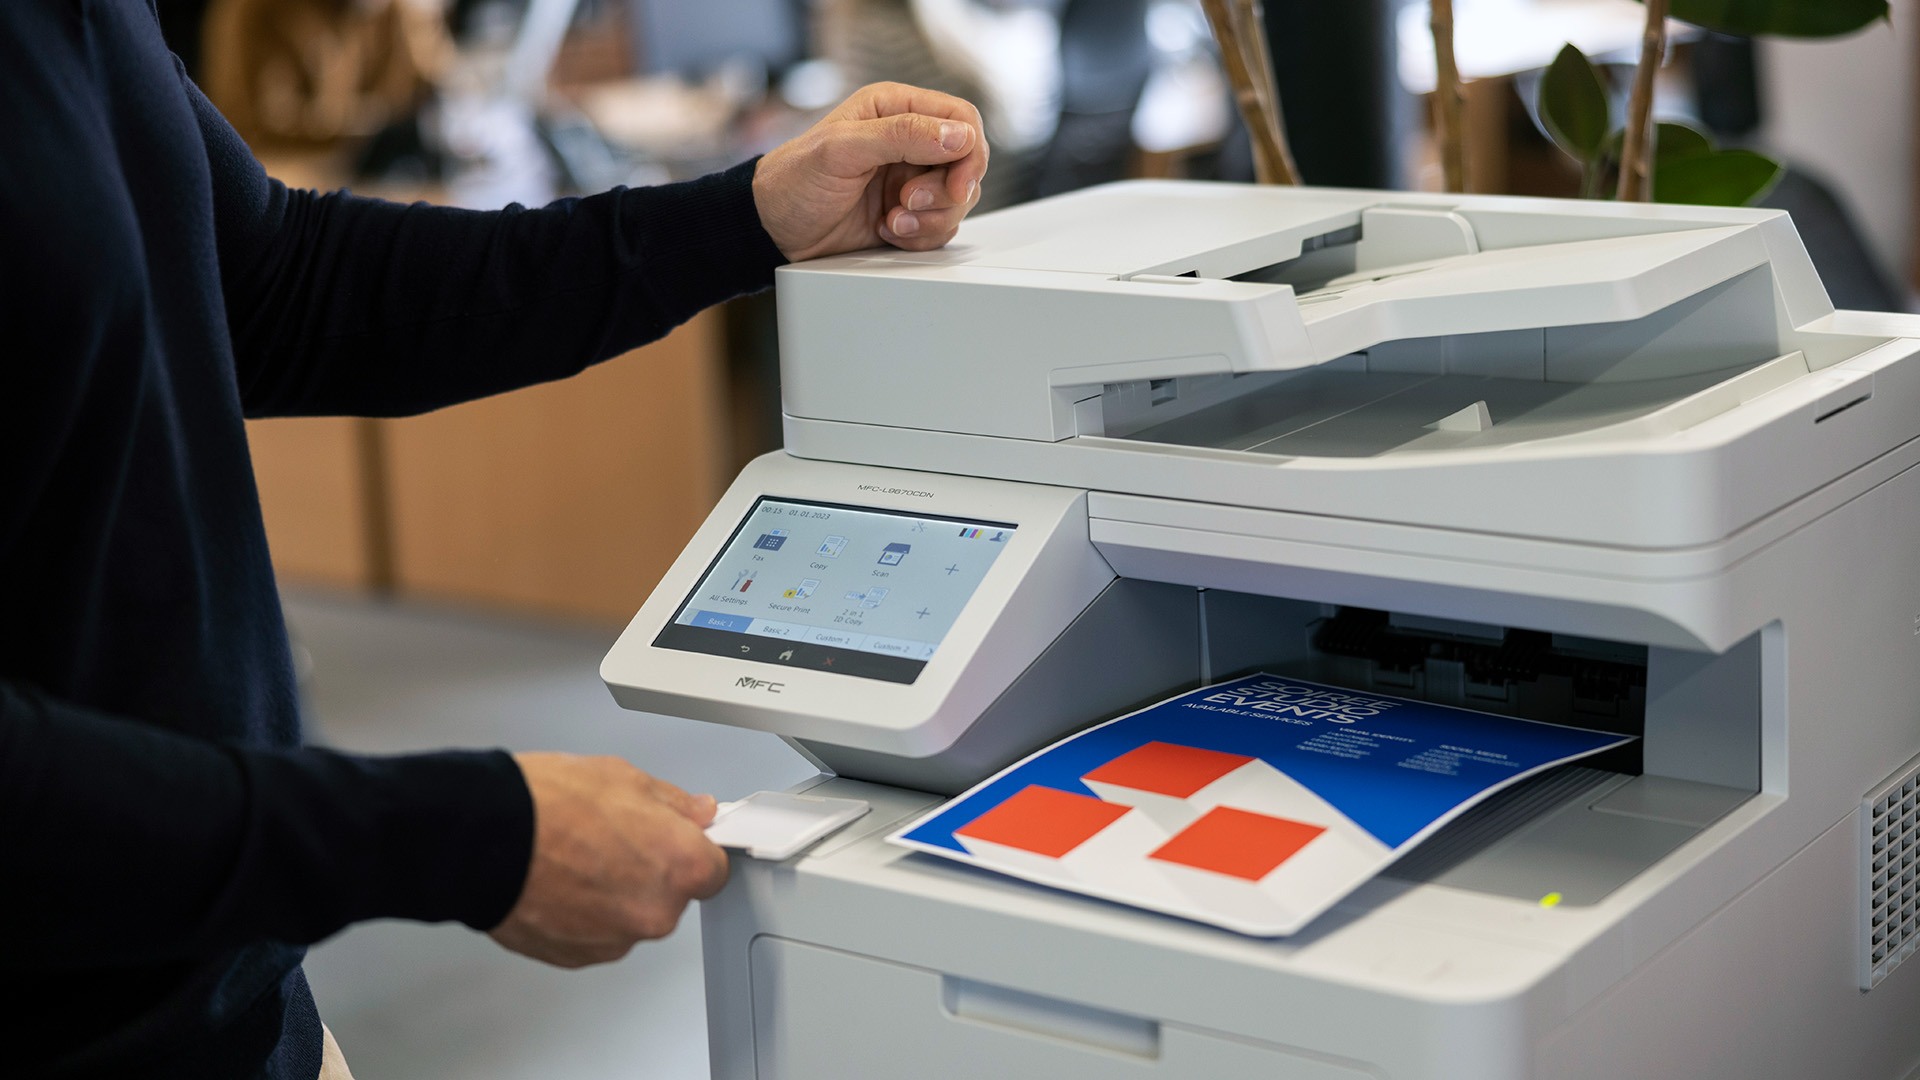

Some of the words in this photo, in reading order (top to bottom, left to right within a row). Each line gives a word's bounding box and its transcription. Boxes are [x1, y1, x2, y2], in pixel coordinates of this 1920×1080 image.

[761, 506, 782, 515] 00:15
[788, 509, 831, 520] 01.01.2023
[752, 554, 765, 562] Fax
[810, 561, 829, 571] Copy
[871, 569, 890, 578] Scan
[709, 594, 719, 602] All
[720, 596, 748, 606] Settings
[768, 602, 792, 613] Secure
[793, 606, 811, 615] Print
[708, 618, 726, 627] Basic
[833, 615, 844, 623] ID
[844, 617, 863, 626] Copy
[763, 625, 781, 635] Basic
[815, 633, 843, 643] Custom
[873, 641, 901, 651] Custom
[735, 676, 785, 694] MFC
[1252, 681, 1402, 710] SOIREE
[1227, 687, 1381, 717] STUDIO
[1182, 702, 1250, 717] AVAILABLE
[1249, 712, 1313, 726] SERVICES
[1202, 693, 1364, 724] EVENTS
